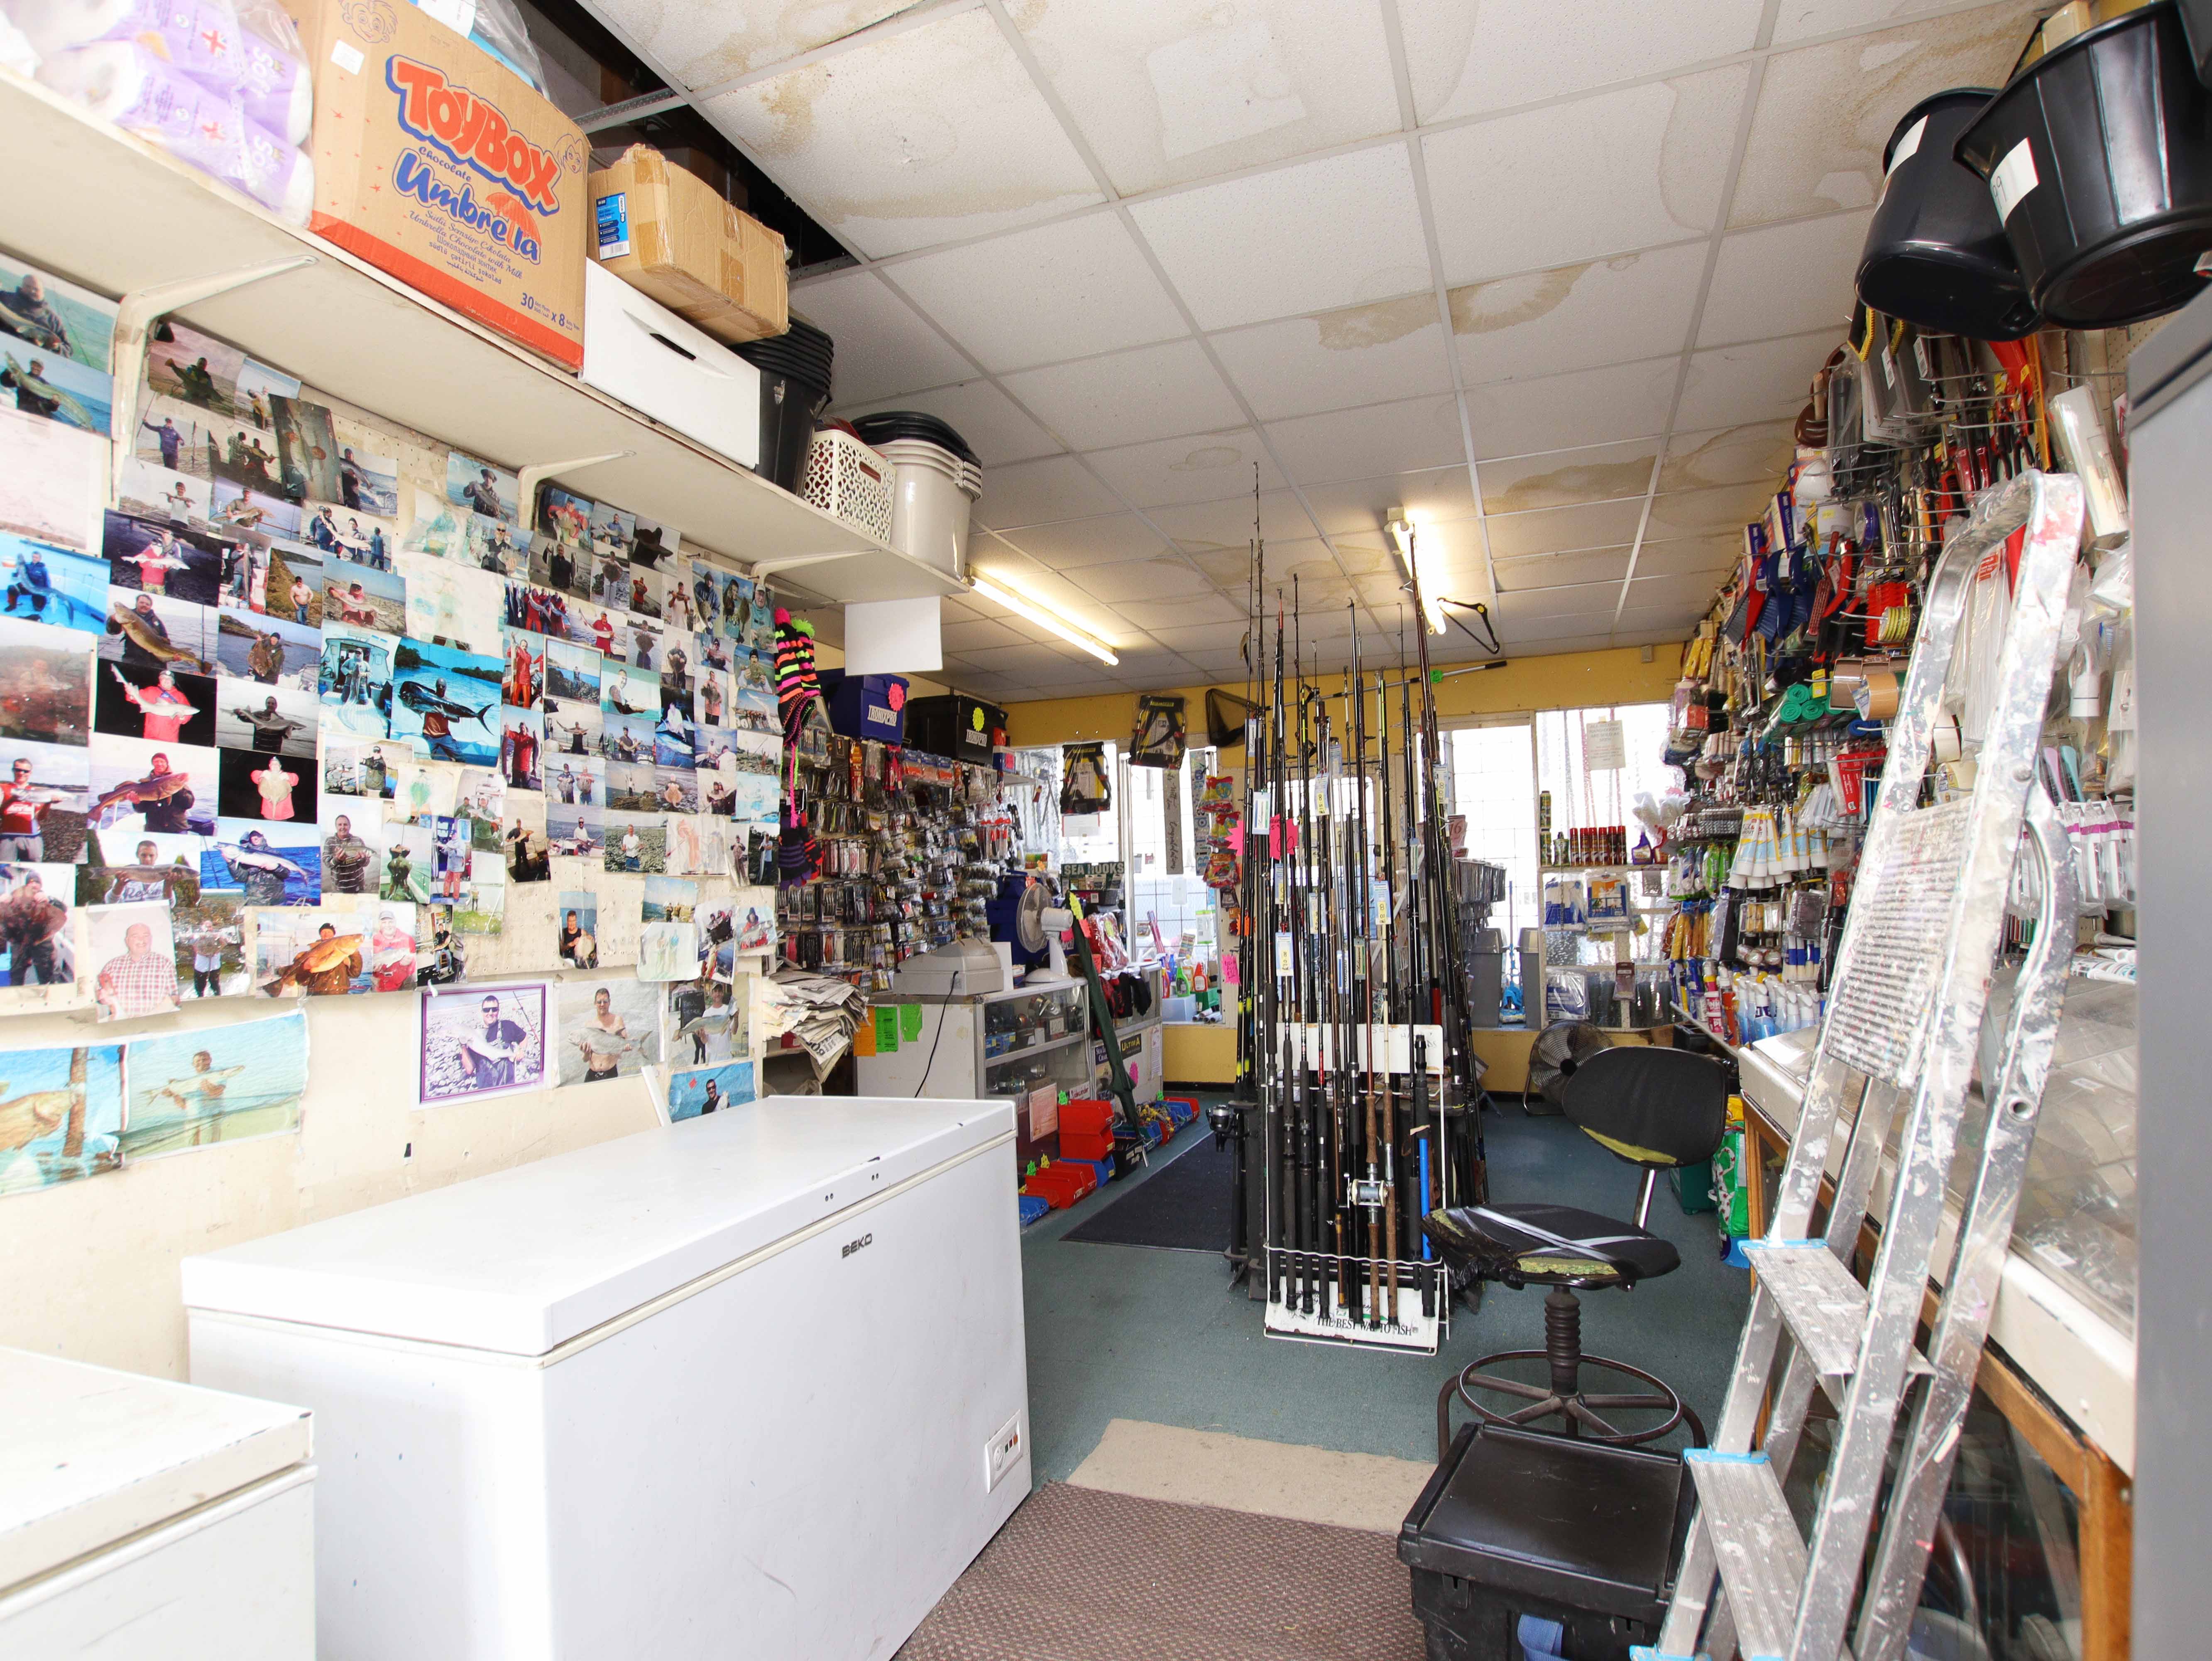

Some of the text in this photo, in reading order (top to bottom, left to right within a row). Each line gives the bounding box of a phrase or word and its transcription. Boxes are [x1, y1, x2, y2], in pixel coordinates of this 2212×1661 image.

[395, 152, 539, 262] Umbrella
[409, 211, 447, 237] Umbrella
[449, 234, 487, 258] Chocolate
[506, 265, 523, 279] Milk
[521, 292, 534, 310] 30
[558, 313, 565, 327] 8
[867, 705, 898, 727] TRONIXPRO
[965, 729, 988, 747] TRONIXPRO
[1168, 820, 1178, 870] Congratulations
[1064, 864, 1085, 875] SEA
[1121, 1037, 1140, 1051] ULTIMA
[841, 1232, 873, 1259] BEKO
[1317, 1318, 1334, 1327] THE
[1336, 1318, 1356, 1329] BEST
